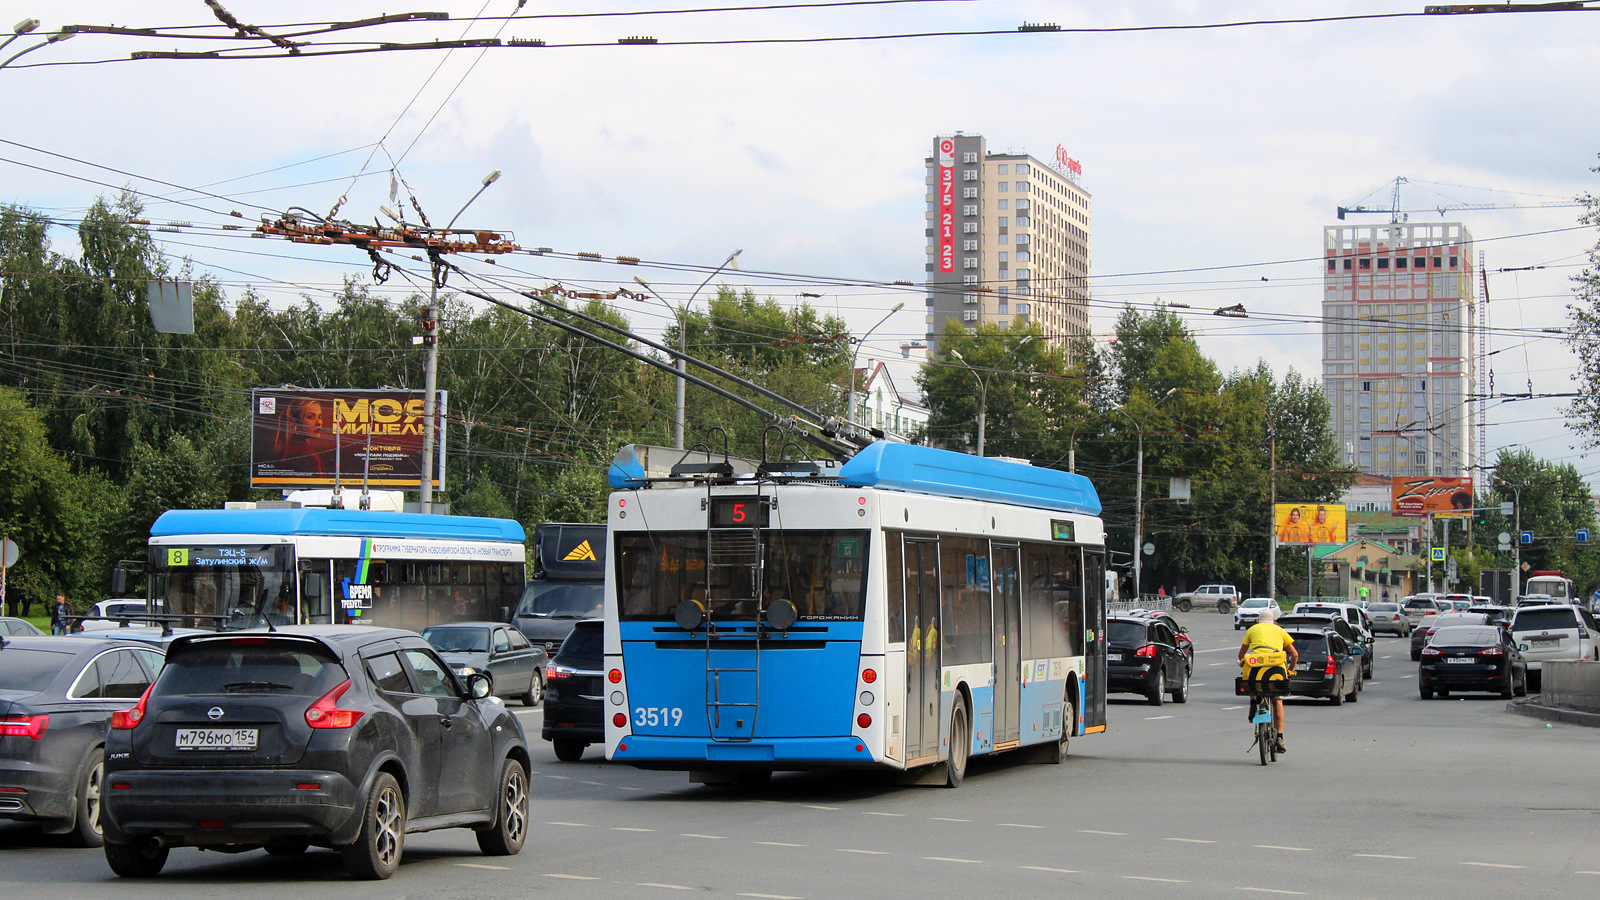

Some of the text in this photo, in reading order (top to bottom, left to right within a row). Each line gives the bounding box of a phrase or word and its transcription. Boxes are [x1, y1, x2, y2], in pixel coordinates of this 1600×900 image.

[732, 503, 747, 523] 5
[219, 549, 246, 557] ТЭЦ-5
[376, 544, 402, 554] ПРОГРАММА
[173, 551, 183, 564] 8
[195, 556, 268, 566] Затулинский ж/м
[349, 585, 372, 599] ВРЕМЯ
[635, 707, 683, 727] 3519
[179, 730, 255, 745] М796МО 154
[108, 752, 130, 761] JUKE
